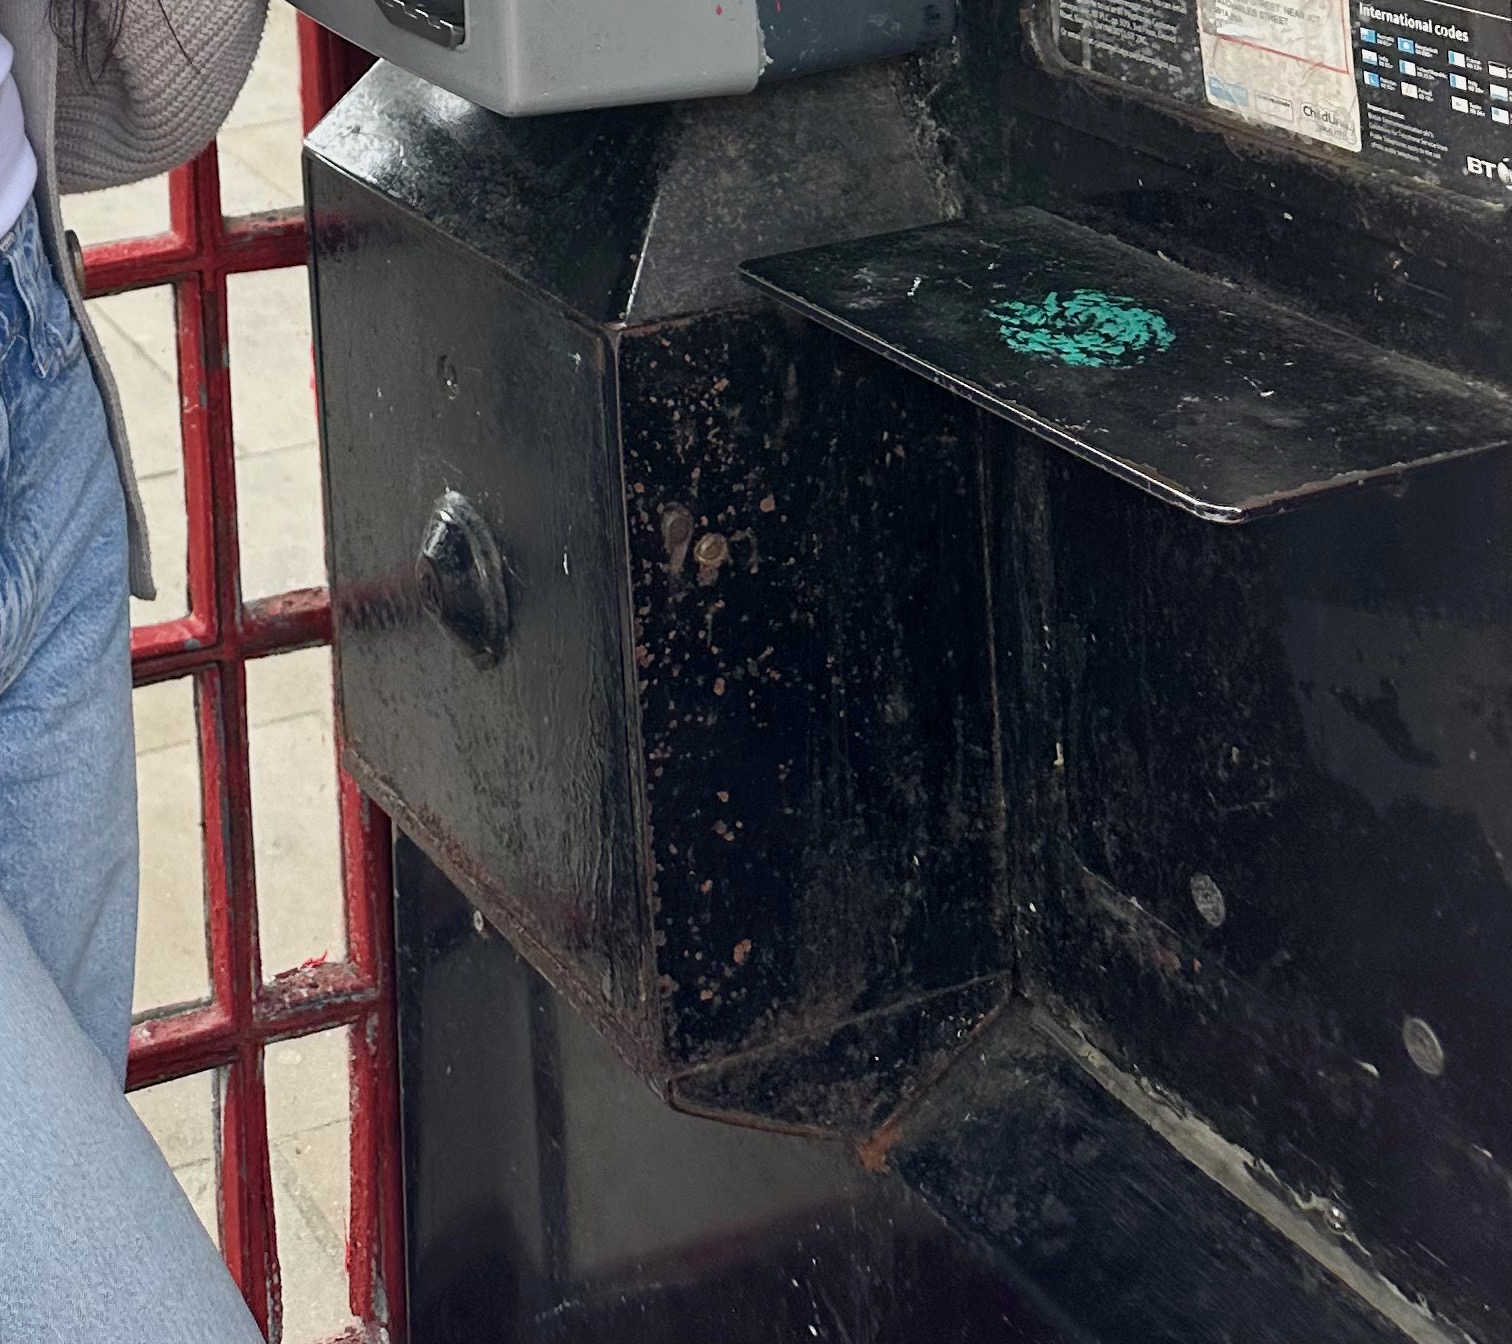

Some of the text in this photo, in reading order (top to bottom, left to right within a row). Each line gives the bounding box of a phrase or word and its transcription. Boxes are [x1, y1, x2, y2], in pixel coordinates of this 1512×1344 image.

[1359, 1, 1469, 42] International codes
[1467, 154, 1497, 179] BT
